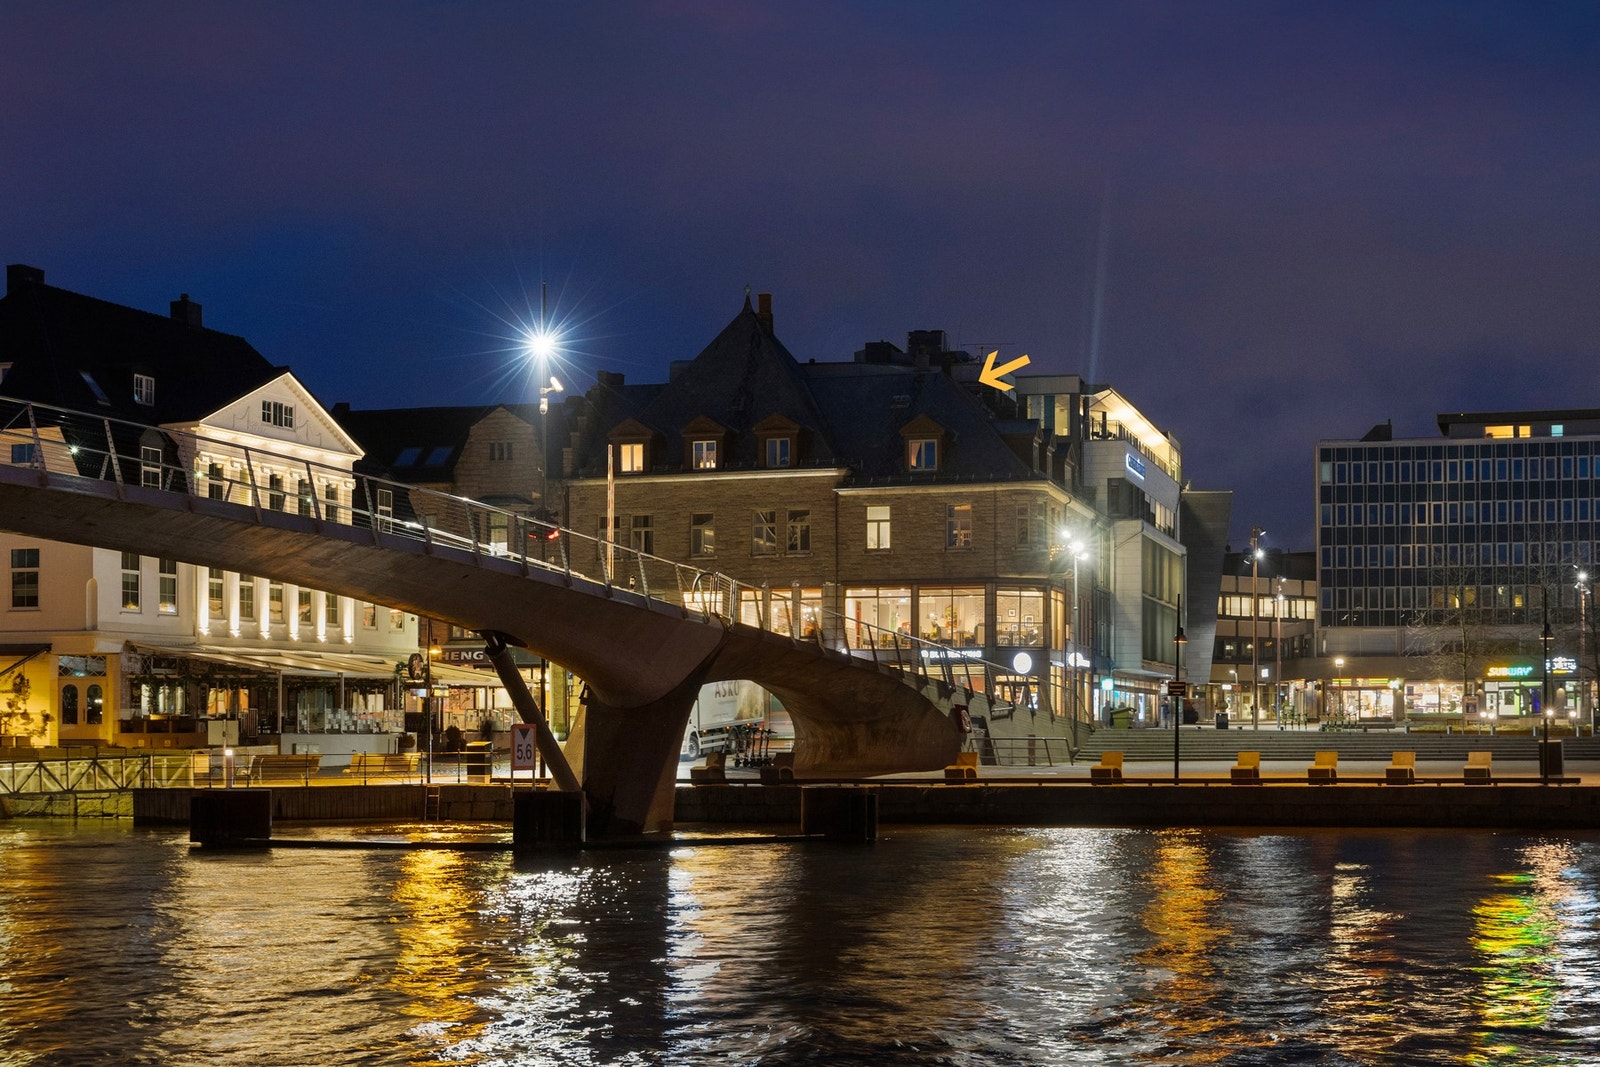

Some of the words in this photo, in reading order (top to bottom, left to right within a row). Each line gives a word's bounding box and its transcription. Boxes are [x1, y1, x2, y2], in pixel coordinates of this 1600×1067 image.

[431, 651, 484, 660] HENG
[1487, 666, 1533, 676] SUBWAY
[715, 680, 739, 698] ASKO
[516, 744, 532, 762] 5,6
